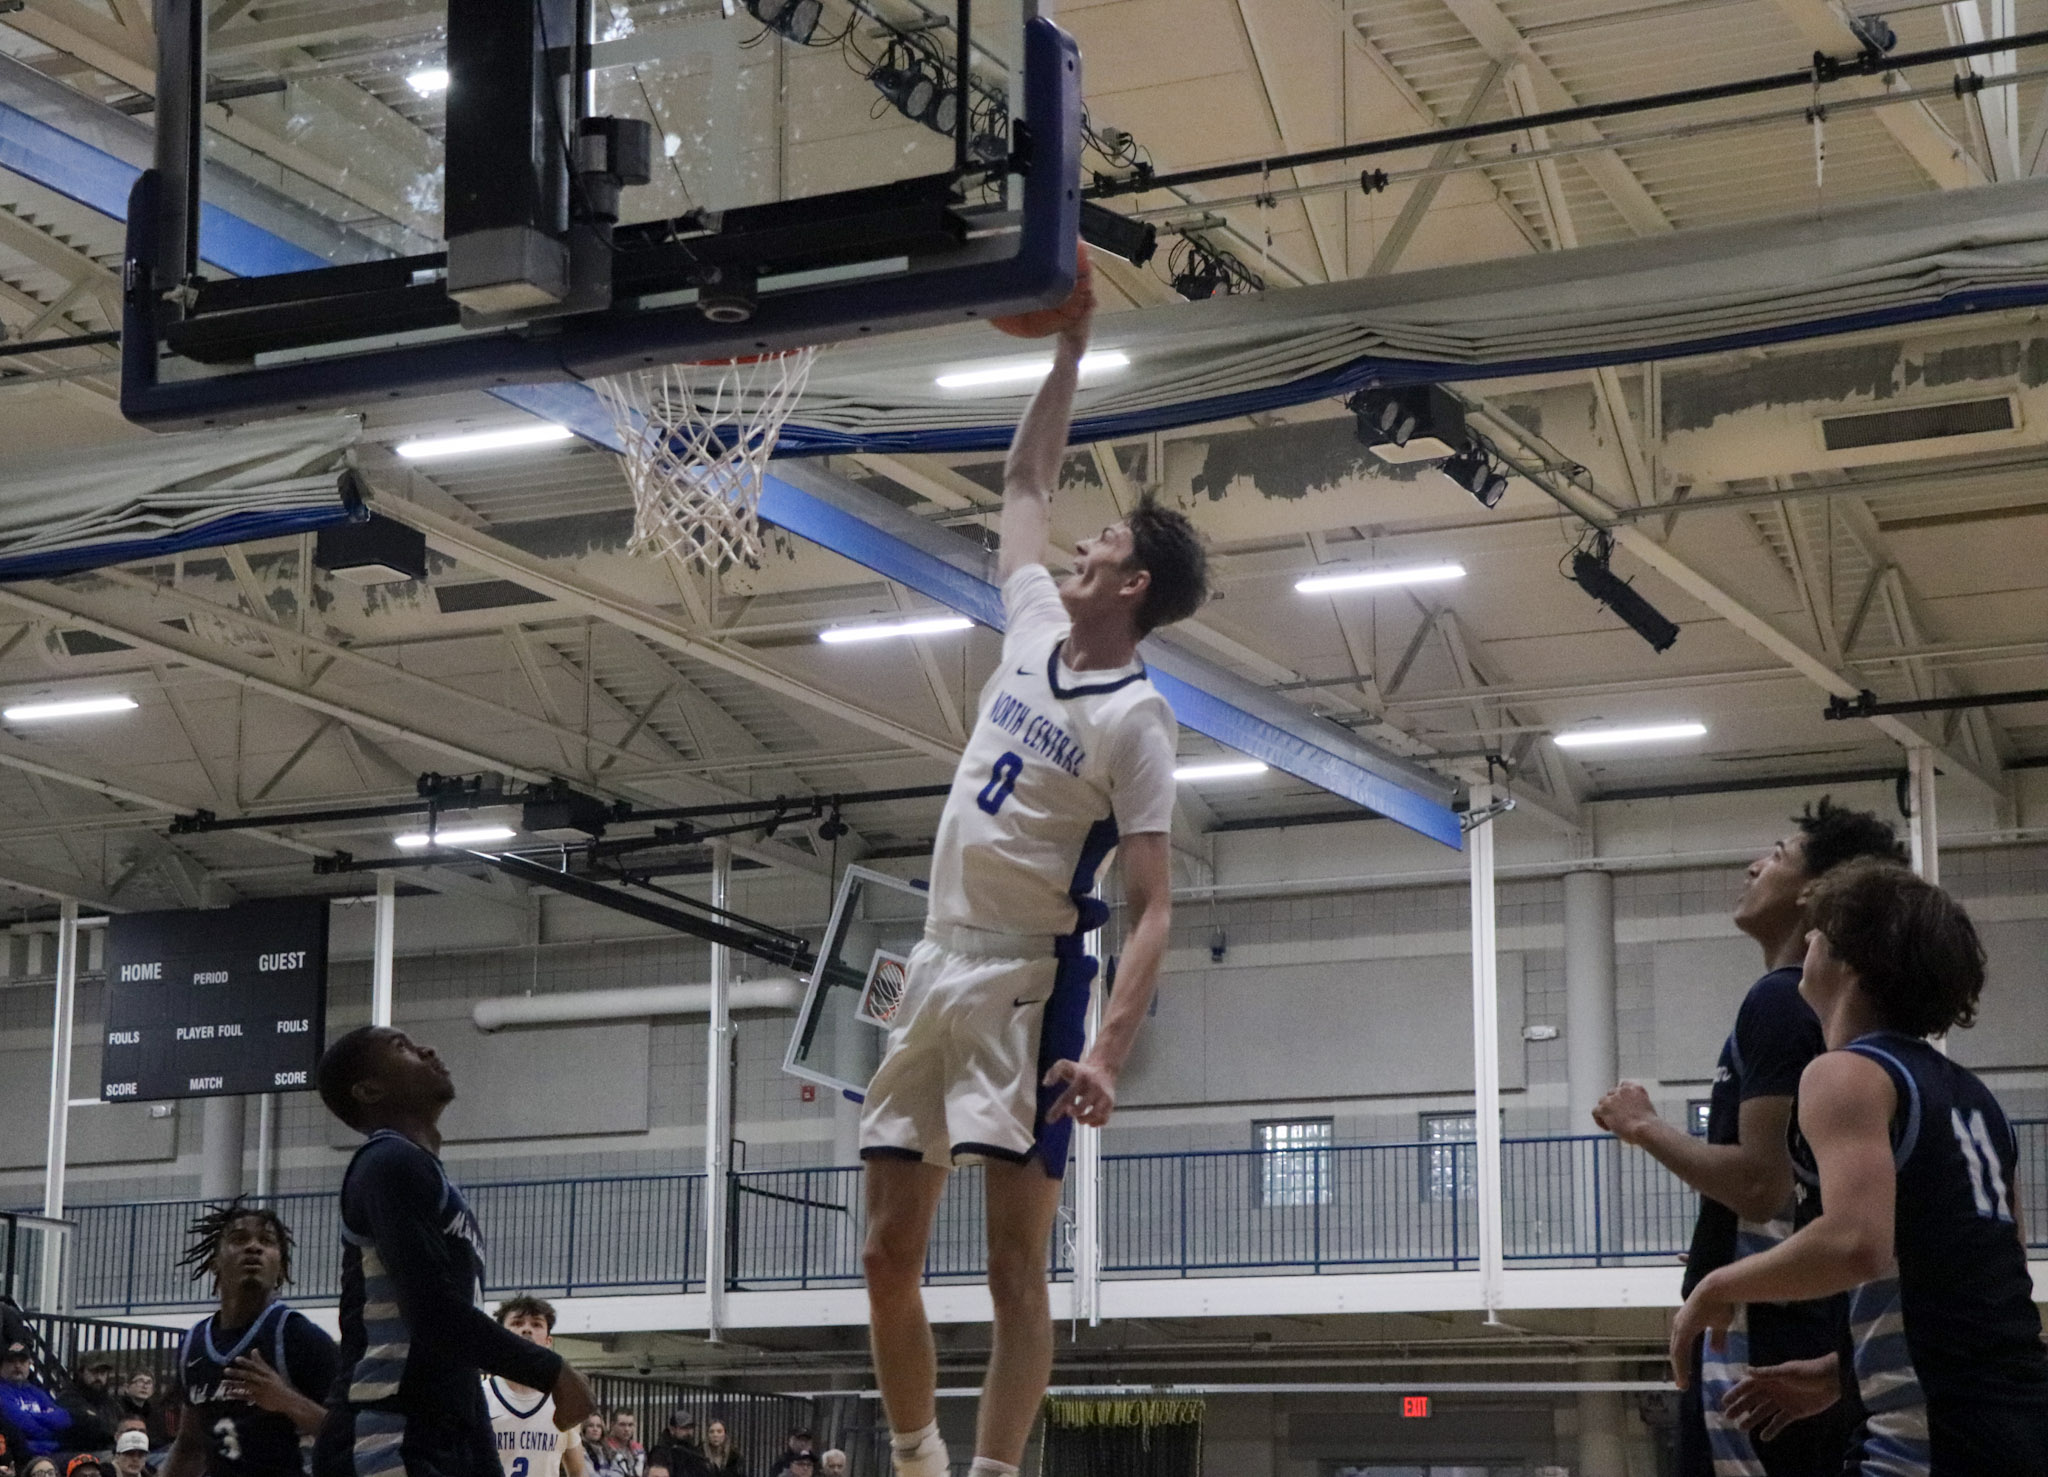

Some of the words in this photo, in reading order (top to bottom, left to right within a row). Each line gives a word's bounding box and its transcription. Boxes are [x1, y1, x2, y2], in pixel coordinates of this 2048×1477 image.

[1023, 715, 1086, 778] CENTRAL
[976, 751, 1024, 816] 0
[258, 952, 306, 972] GUEST
[121, 962, 162, 982] HOME
[193, 971, 229, 985] PERIOD
[176, 1026, 214, 1040] PLAYER
[218, 1024, 243, 1037] FOUL
[277, 1019, 309, 1033] FOULS
[109, 1031, 140, 1045] FOULS
[189, 1077, 223, 1090] MATCH
[274, 1071, 307, 1085] SCORE
[105, 1082, 137, 1096] SCORE
[1951, 1107, 2016, 1223] 11
[1404, 1396, 1428, 1417] EXIT
[213, 1418, 241, 1459] 3
